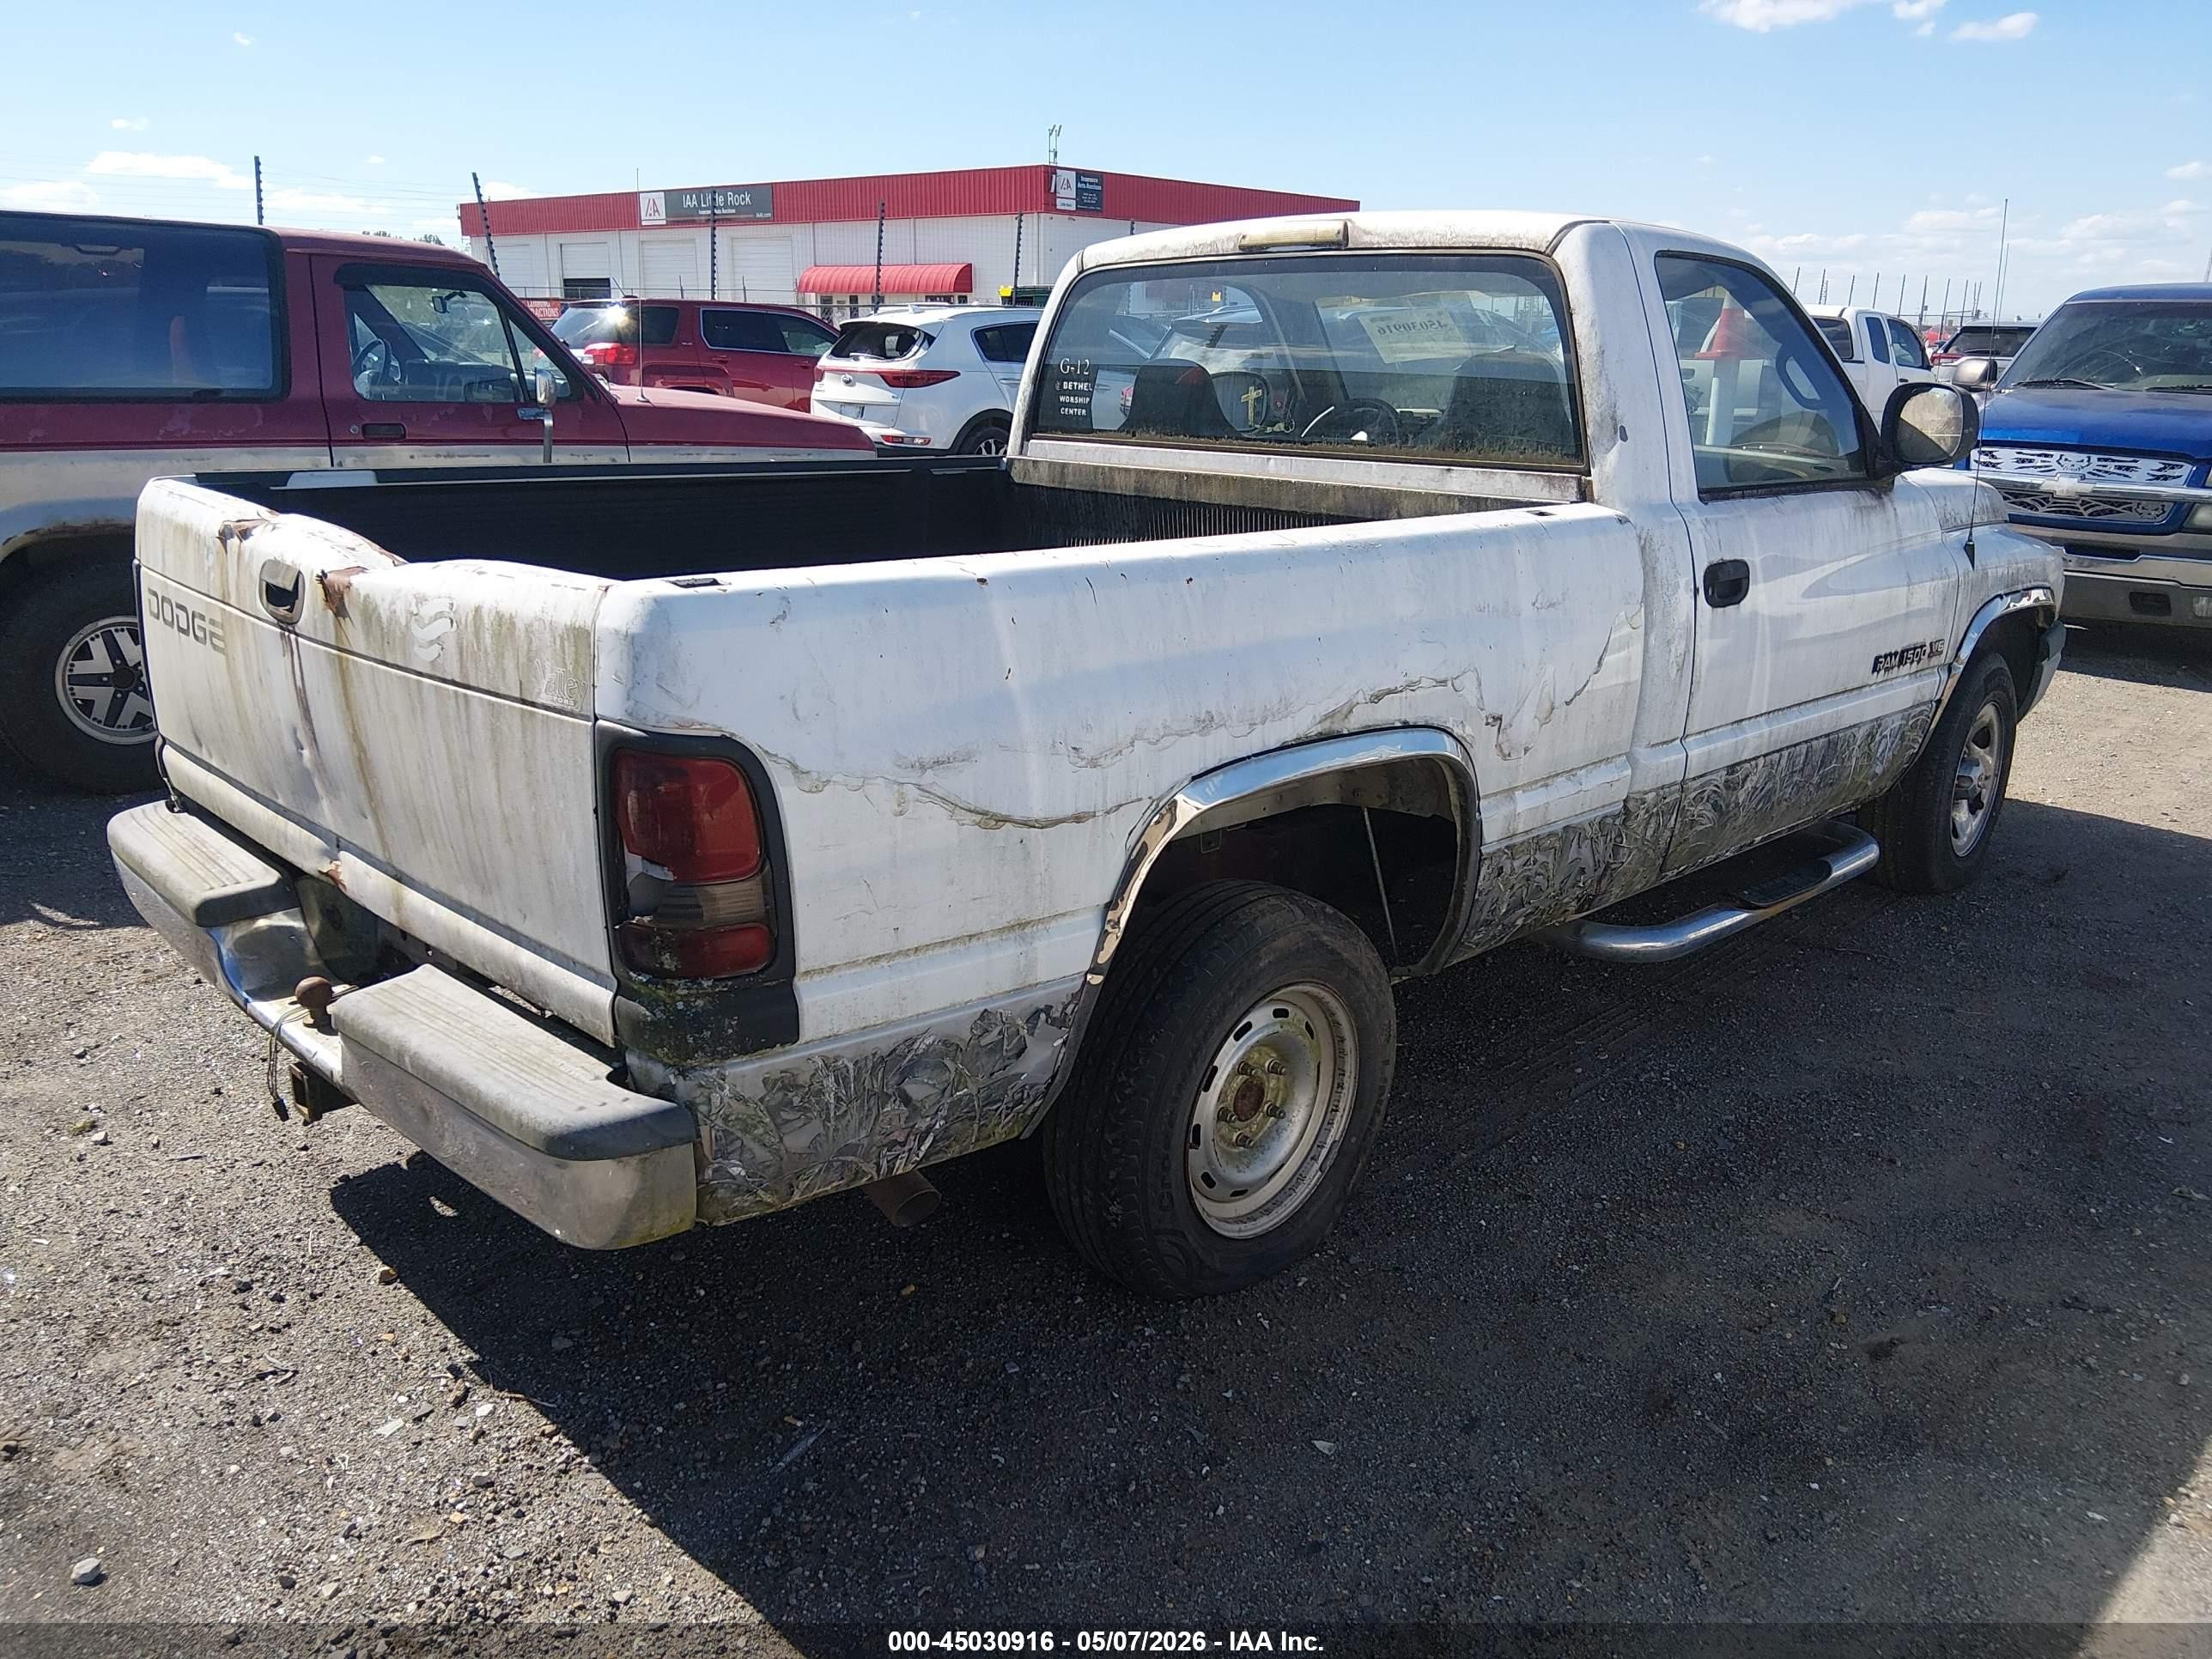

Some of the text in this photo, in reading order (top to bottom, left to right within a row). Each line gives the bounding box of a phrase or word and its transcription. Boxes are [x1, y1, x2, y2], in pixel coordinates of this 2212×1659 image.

[683, 191, 752, 208] IAA Litle Rock
[1060, 357, 1090, 374] G-12
[1063, 381, 1093, 391] BETHEL
[1059, 395, 1090, 404] WORSHIP
[1060, 407, 1086, 416] CENTER
[148, 587, 227, 656] DODGE
[1877, 654, 1900, 671] RAM
[1902, 647, 1928, 665] 1500
